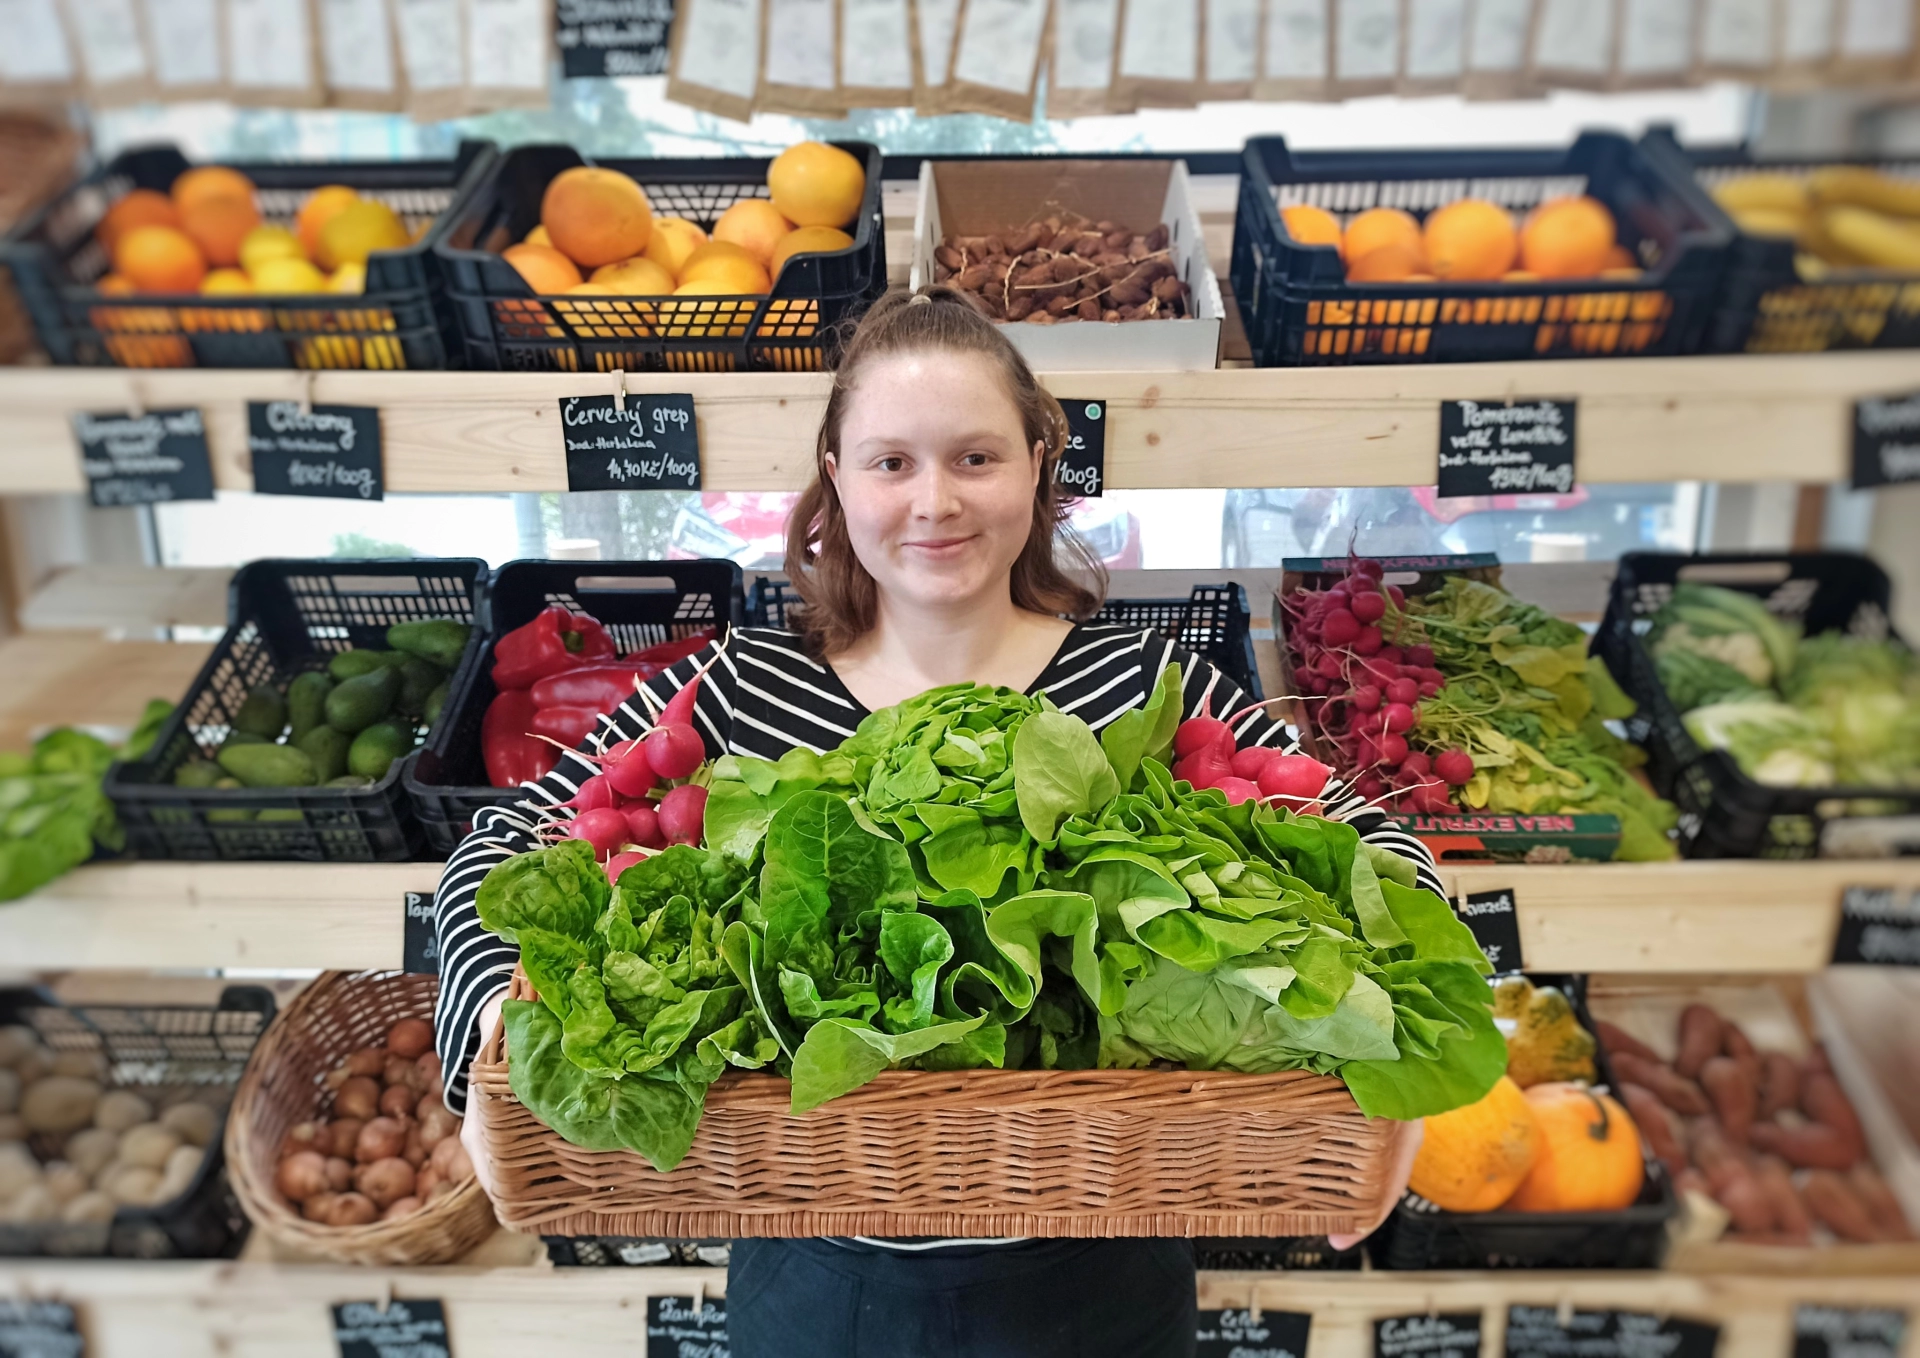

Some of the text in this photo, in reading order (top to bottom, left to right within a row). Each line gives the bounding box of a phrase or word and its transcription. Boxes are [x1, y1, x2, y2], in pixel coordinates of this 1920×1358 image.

[565, 398, 689, 437] Červený grep
[1413, 815, 1516, 832] EXFRUT
[1517, 815, 1575, 832] NEA
